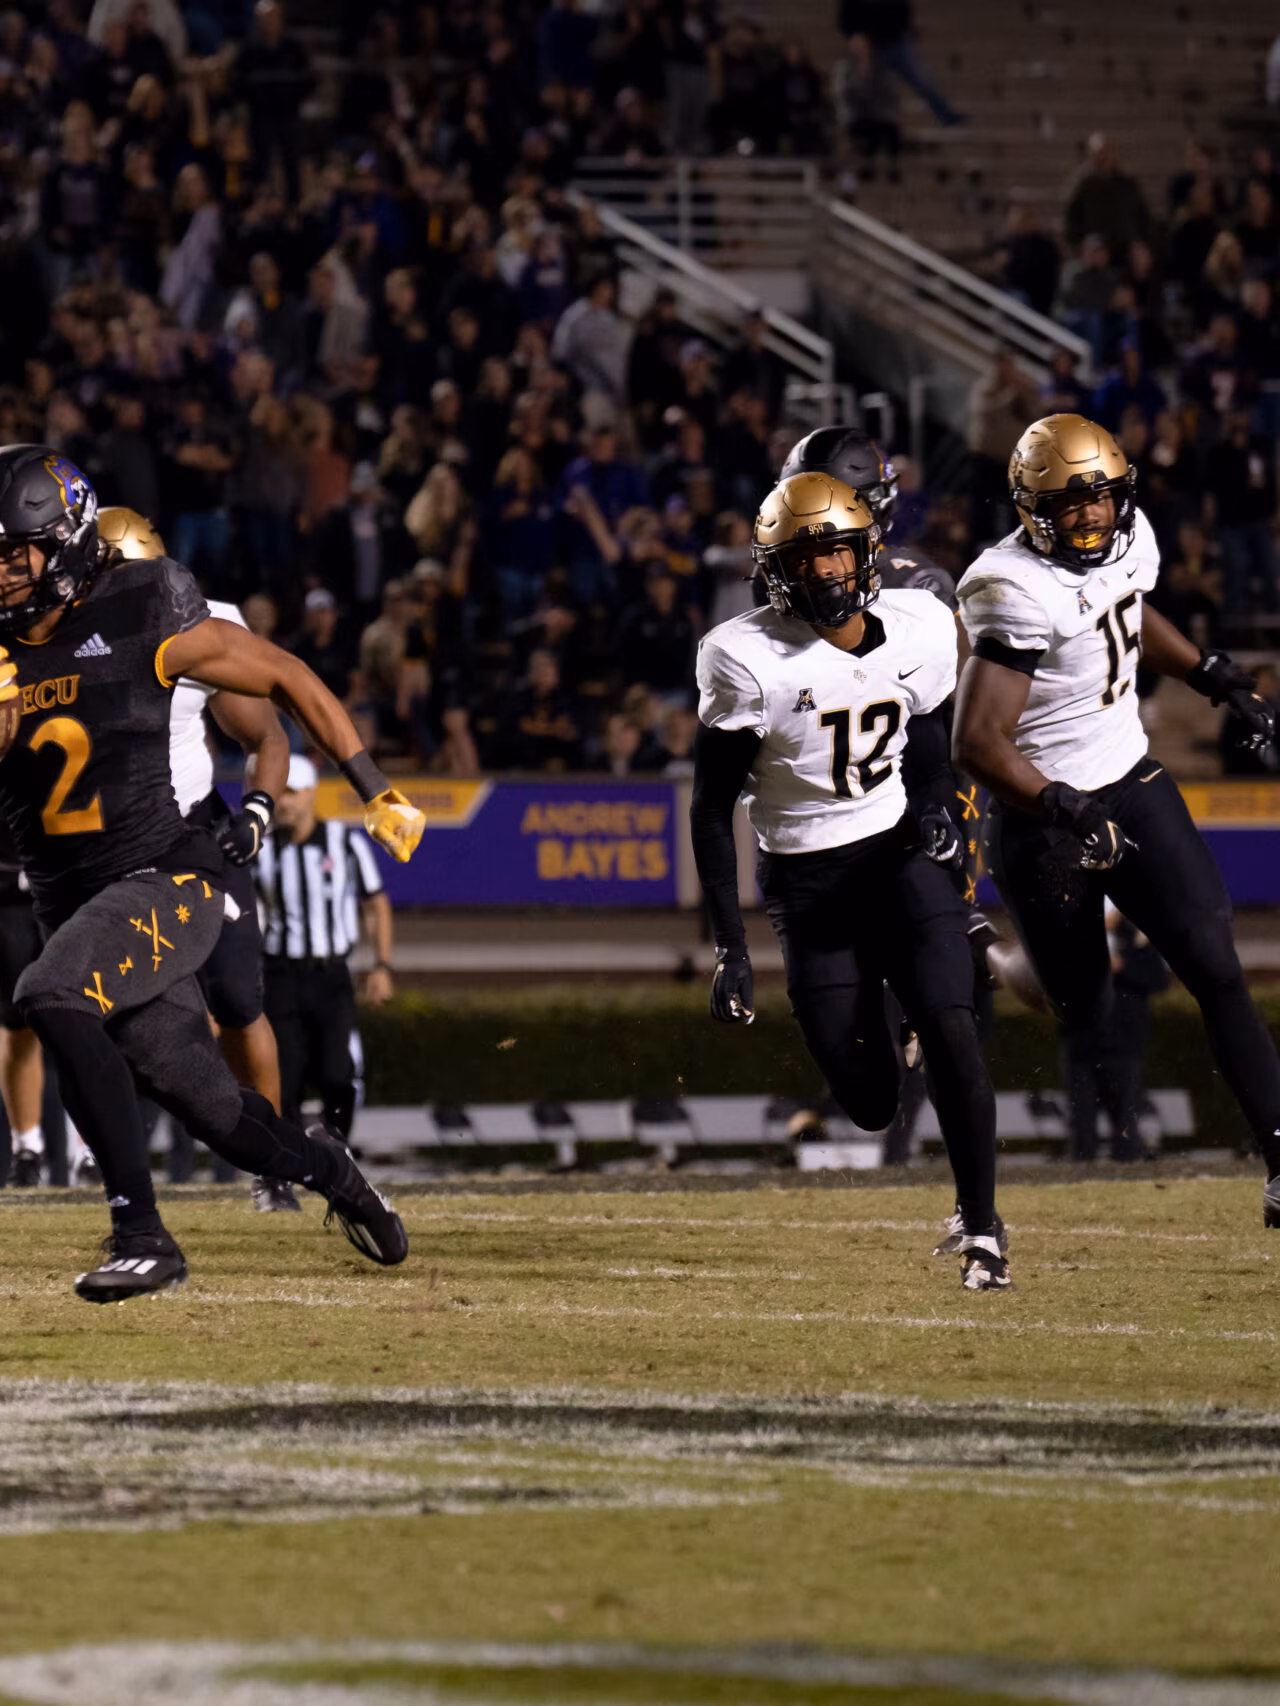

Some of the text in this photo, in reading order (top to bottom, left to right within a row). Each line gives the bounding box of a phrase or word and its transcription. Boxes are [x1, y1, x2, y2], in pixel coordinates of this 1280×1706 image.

[73, 645, 113, 658] adidas
[1095, 588, 1141, 707] 15
[20, 674, 81, 715] ECU
[817, 697, 902, 799] 12
[27, 714, 106, 837] 2
[522, 801, 669, 836] ANDREW
[536, 839, 668, 881] BAYES
